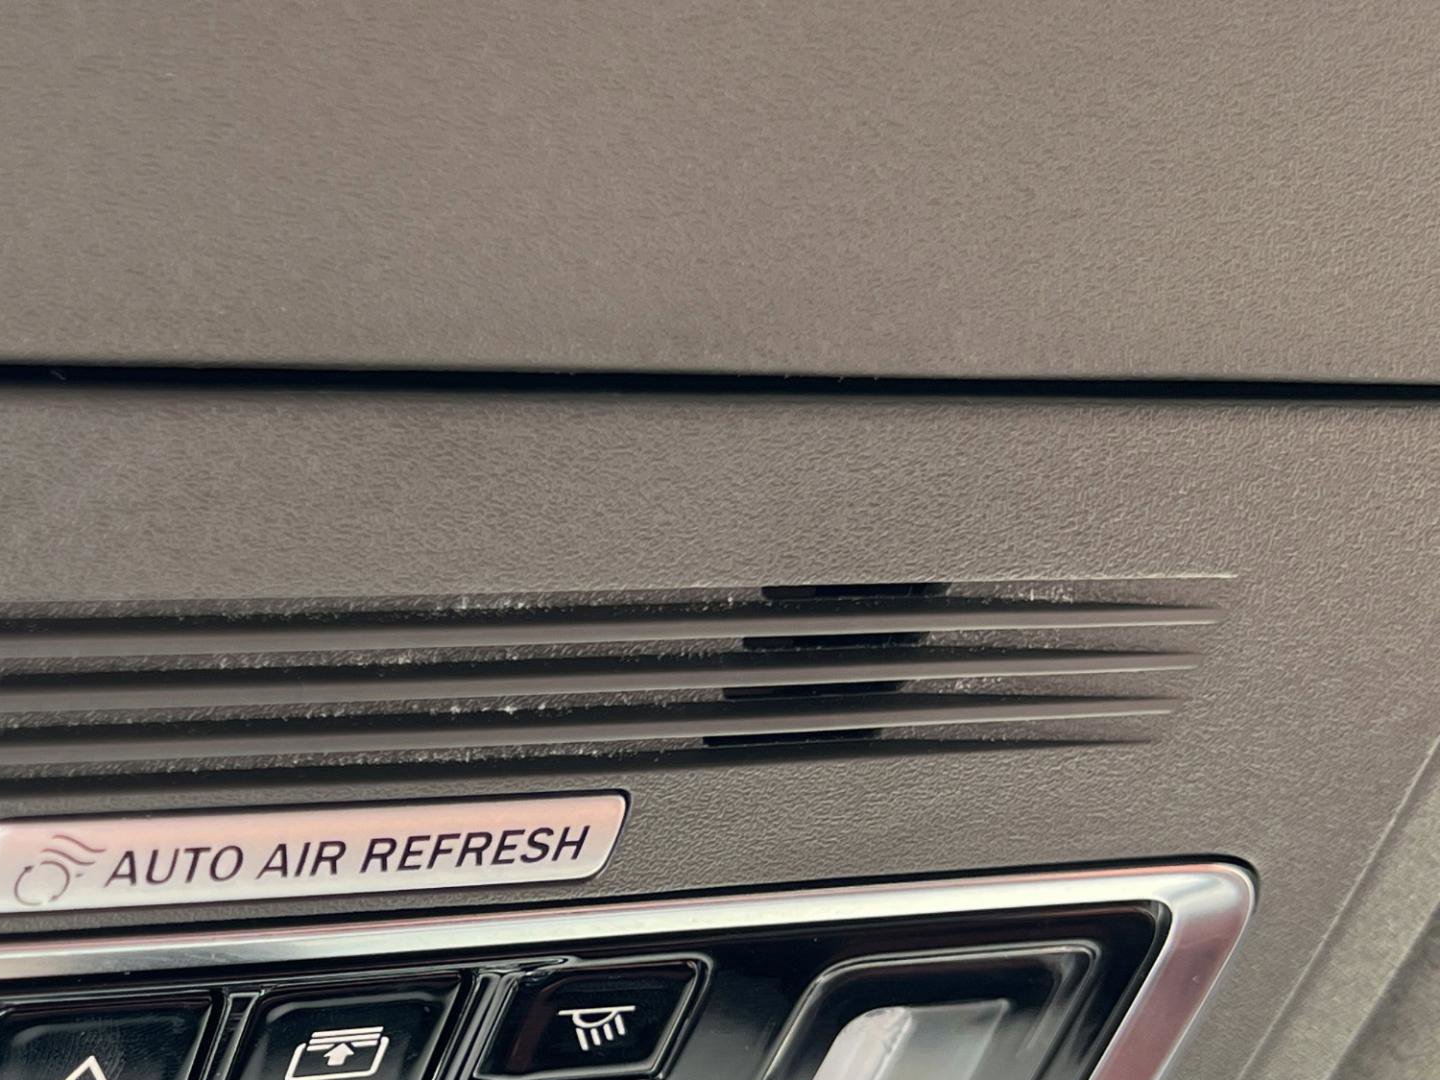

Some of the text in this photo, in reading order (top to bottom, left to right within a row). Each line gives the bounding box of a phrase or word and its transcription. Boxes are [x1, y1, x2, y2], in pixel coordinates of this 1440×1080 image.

[104, 825, 591, 887] AUTO AIR REFRESH
